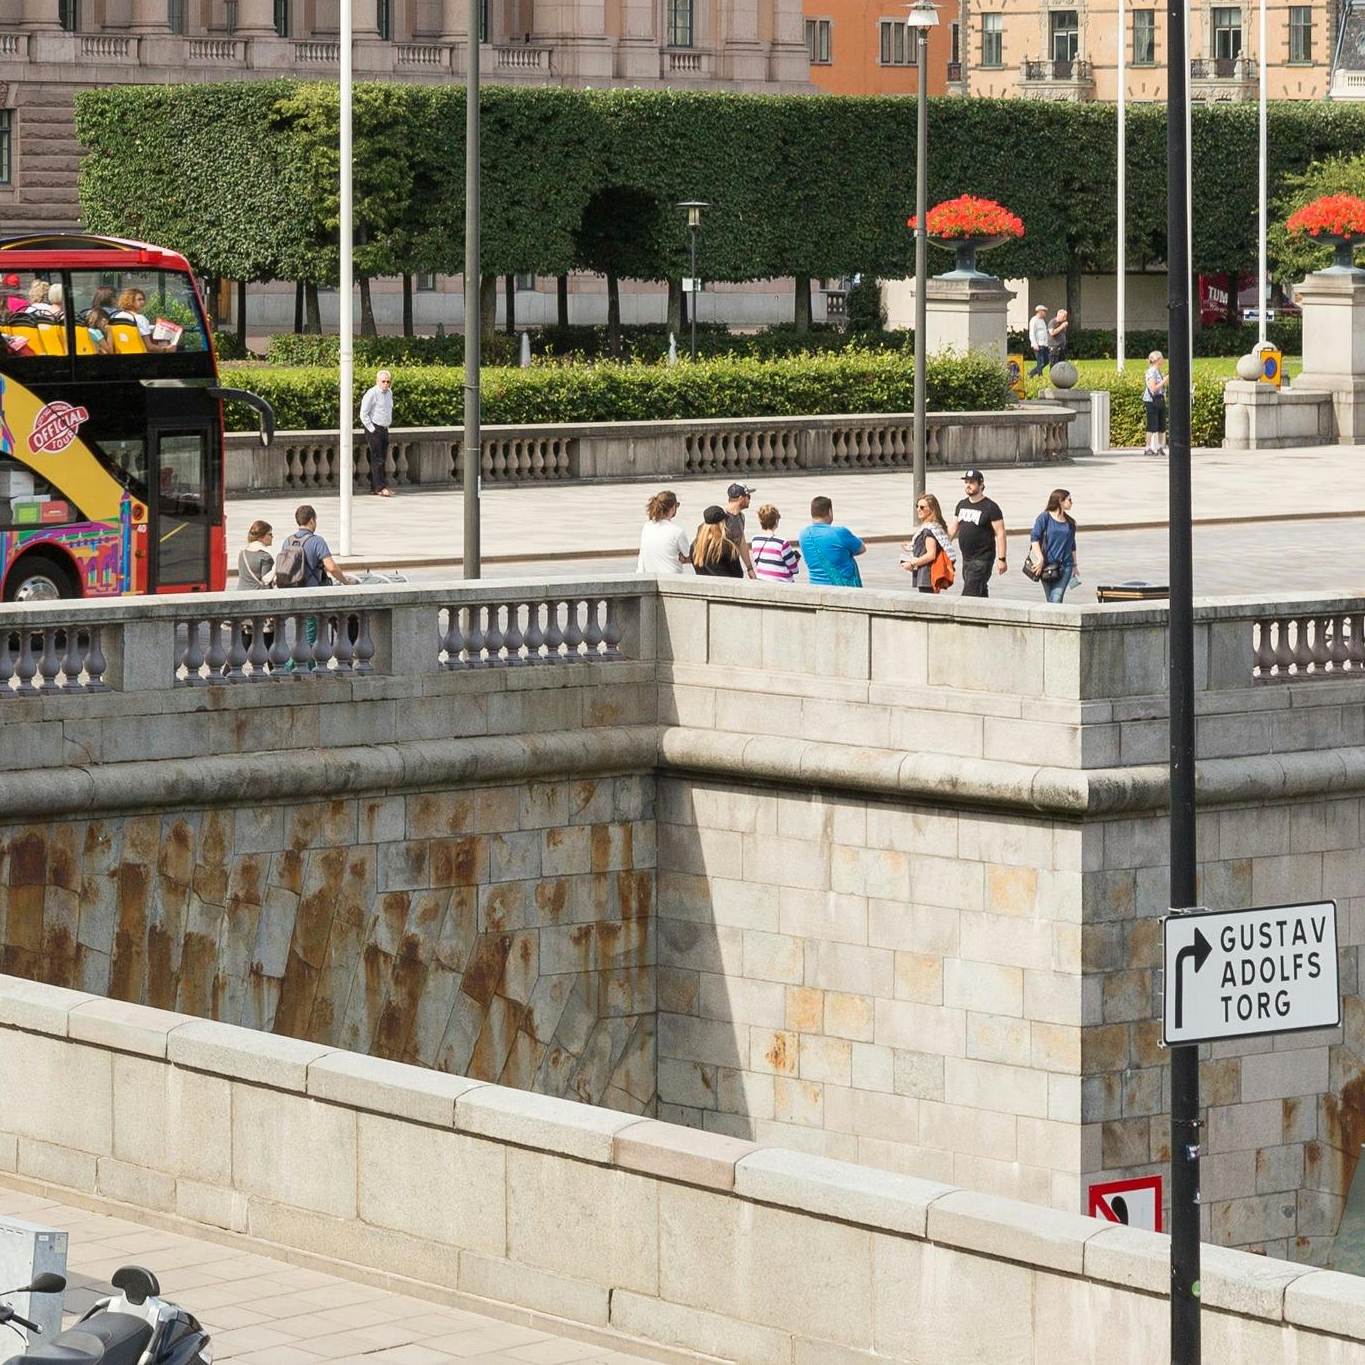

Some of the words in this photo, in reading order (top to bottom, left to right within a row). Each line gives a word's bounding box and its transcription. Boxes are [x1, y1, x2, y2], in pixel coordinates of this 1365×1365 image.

[33, 408, 86, 448] OFFICIAL
[1220, 916, 1326, 953] GUSTAV
[1220, 951, 1321, 988] ADOLFS
[1220, 989, 1291, 1023] TORG
